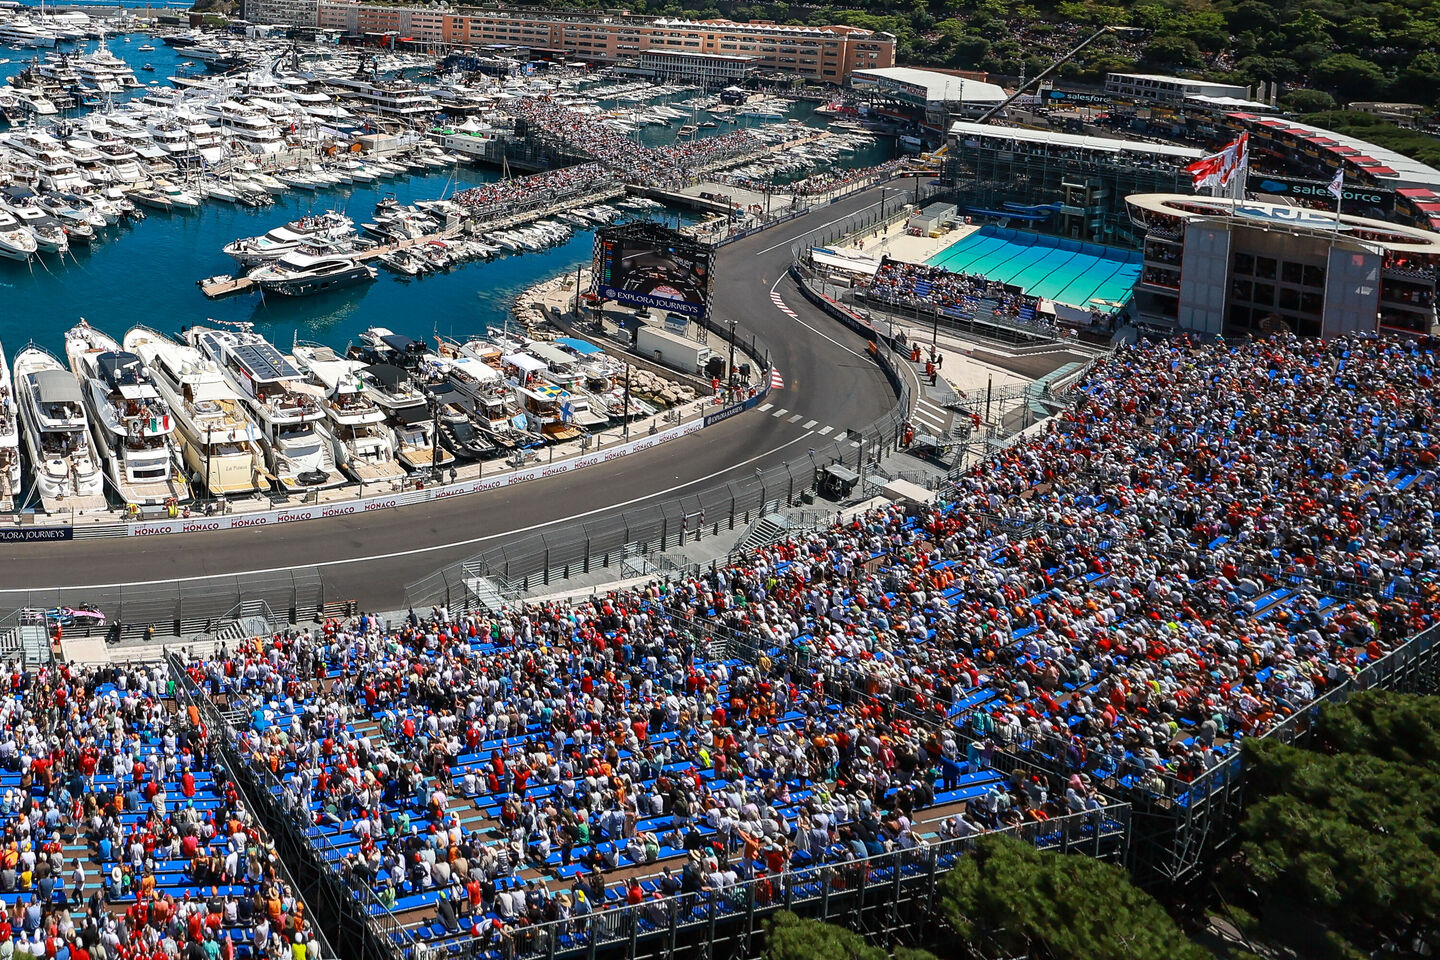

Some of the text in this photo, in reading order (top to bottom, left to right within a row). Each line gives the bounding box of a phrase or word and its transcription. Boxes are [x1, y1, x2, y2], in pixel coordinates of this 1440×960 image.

[1067, 93, 1108, 102] salesforc
[1292, 185, 1382, 204] salesorce
[617, 292, 698, 313] EXPLORA JOURNEYS
[633, 441, 653, 452] MONACO
[605, 449, 627, 461] MONACO
[574, 458, 598, 469] MONACO
[542, 466, 568, 477] MONACO
[509, 473, 535, 484] MONACO
[473, 481, 500, 492] MONACO
[365, 500, 396, 510] MONACO
[322, 506, 355, 516] MONACO
[278, 512, 311, 522] MONACO
[184, 523, 219, 532] MONACO
[231, 518, 266, 528] MONACO
[25, 530, 65, 540] JOURNEYS
[135, 527, 171, 536] MONACO
